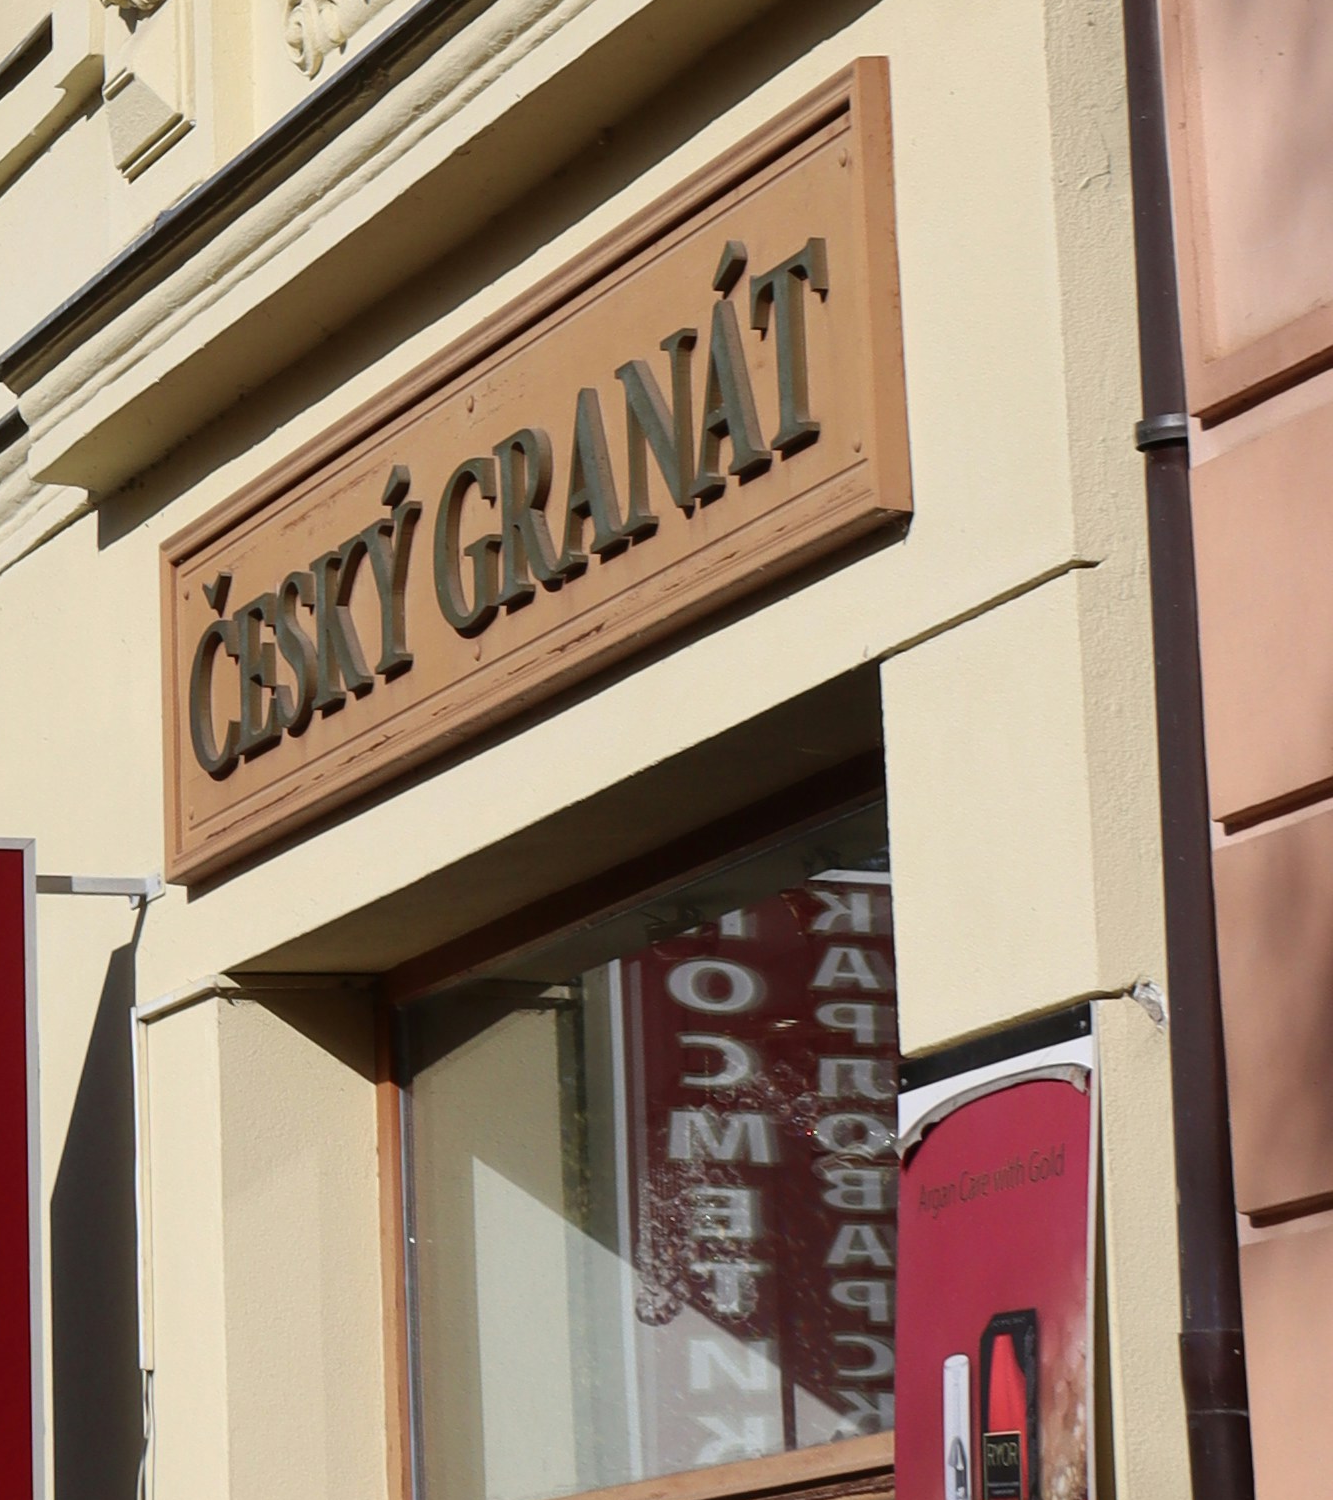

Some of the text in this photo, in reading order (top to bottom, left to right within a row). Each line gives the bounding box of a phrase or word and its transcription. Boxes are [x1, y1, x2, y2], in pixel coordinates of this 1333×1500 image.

[189, 237, 830, 778] ČESKÝ GRANÁT
[919, 1142, 1065, 1220] Argan Care with Gold
[987, 1441, 1019, 1467] RYOR
